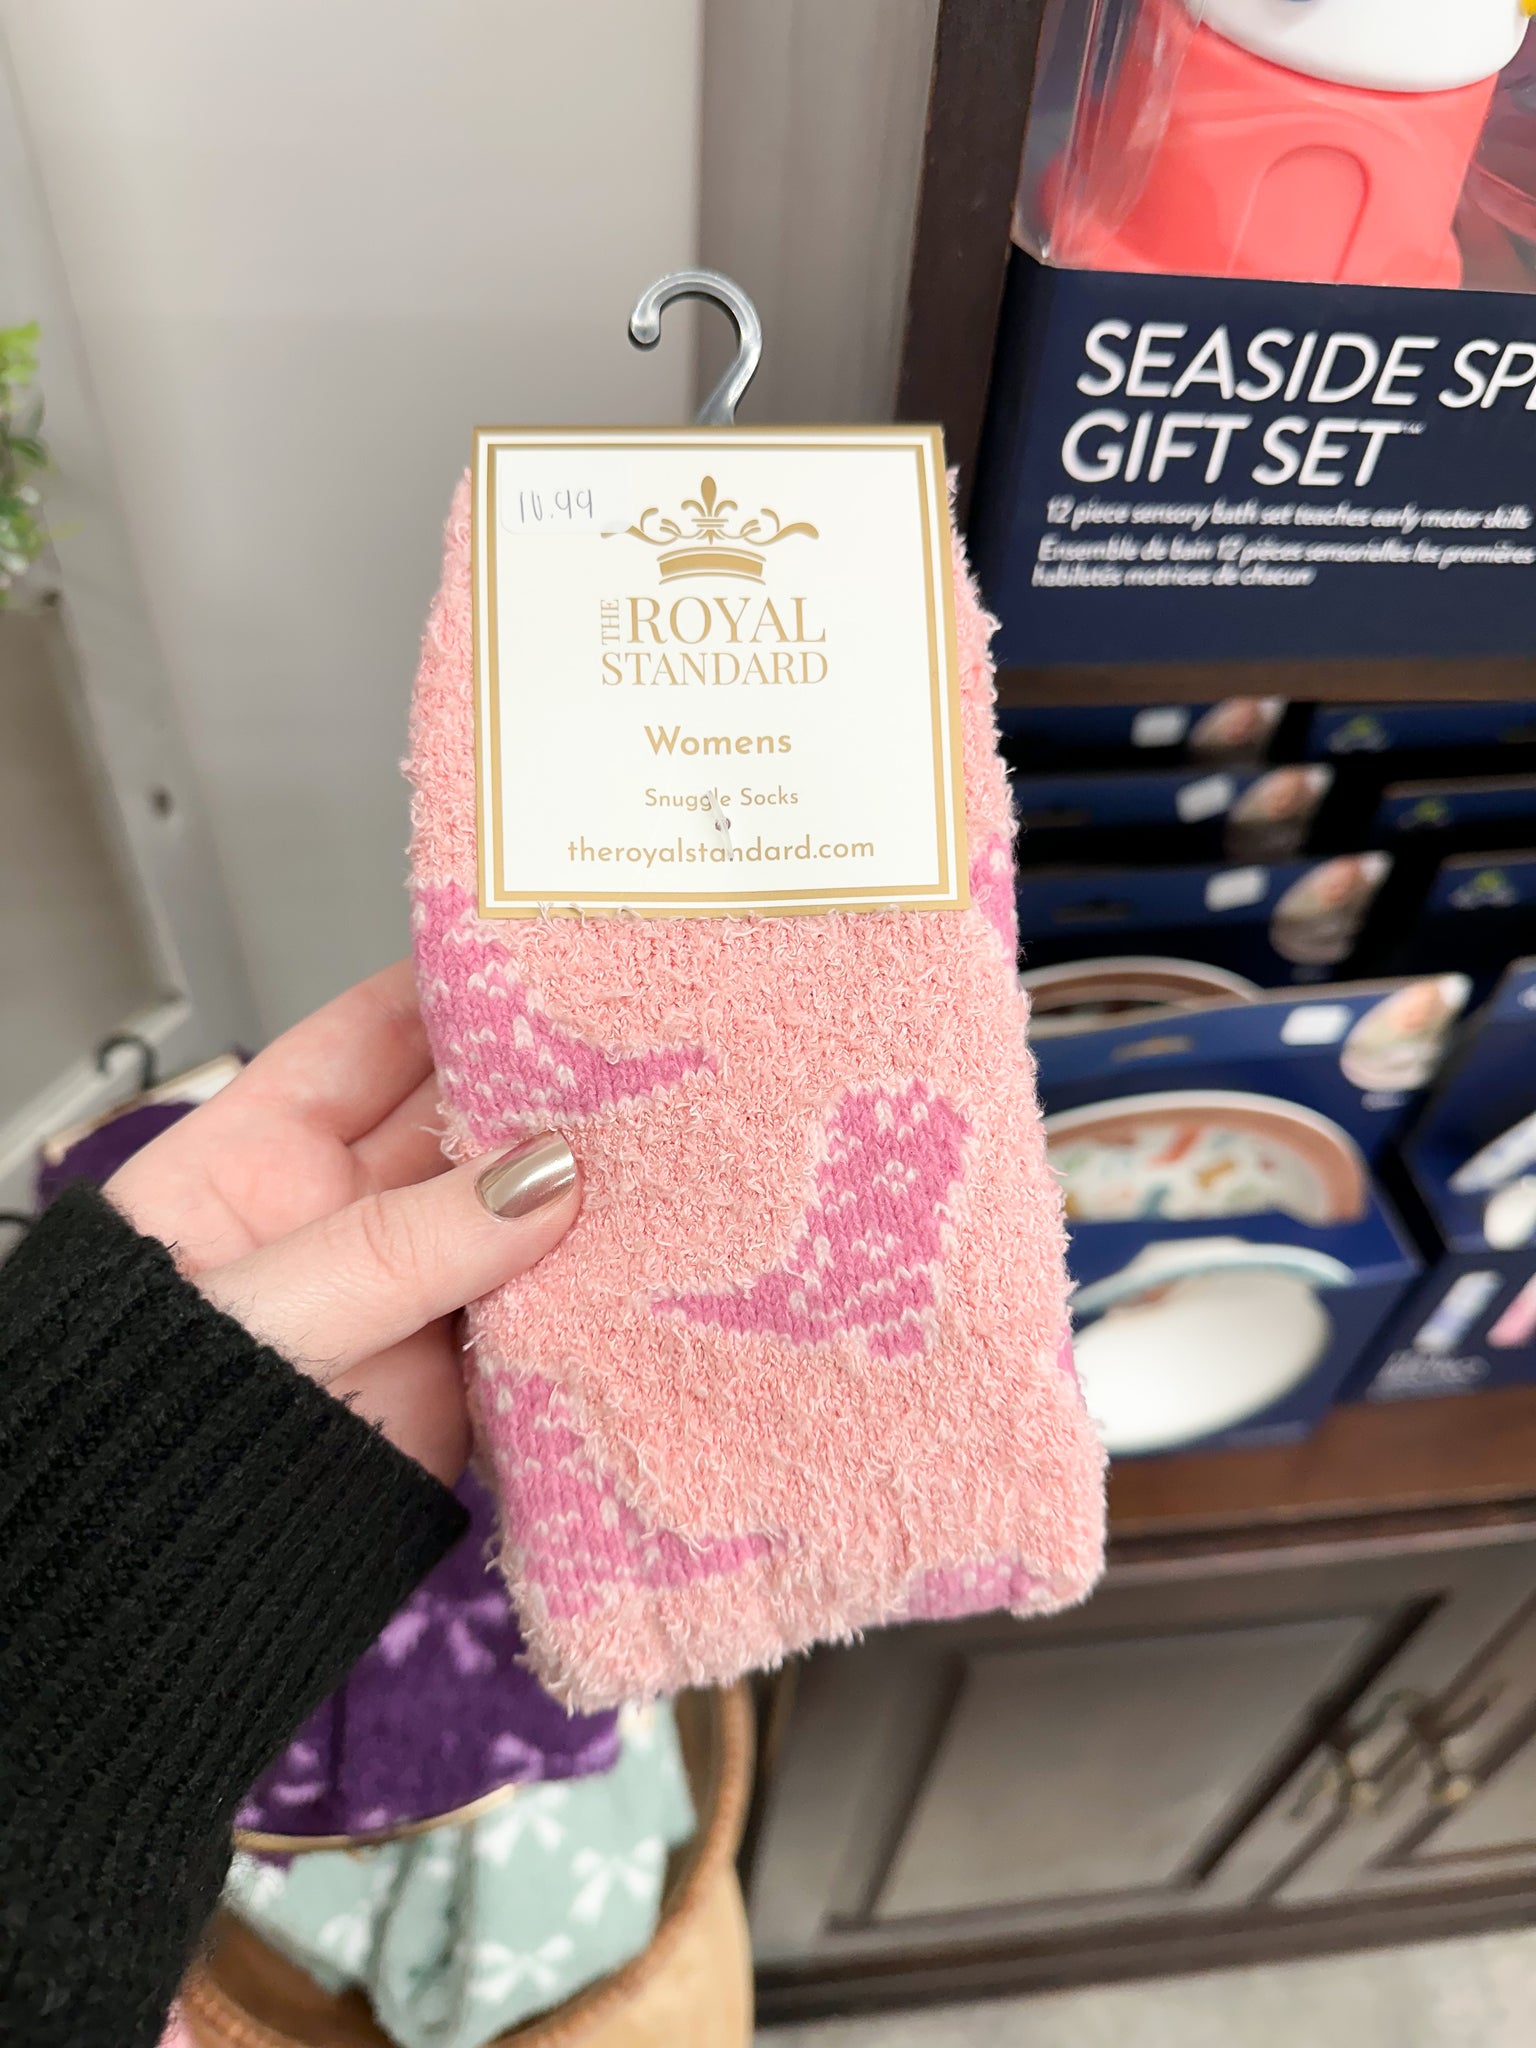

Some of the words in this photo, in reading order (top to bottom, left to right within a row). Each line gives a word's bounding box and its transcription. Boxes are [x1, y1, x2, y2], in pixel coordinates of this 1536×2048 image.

[1076, 319, 1440, 406] SEASIDE
[1438, 338, 1536, 411] SP
[1061, 408, 1253, 484] GIFT
[519, 488, 593, 524] 10.99
[1047, 494, 1076, 524] 12
[1071, 495, 1130, 531] piece
[1130, 502, 1212, 532] sensory
[1210, 495, 1260, 525] bath
[1259, 502, 1297, 526] set
[1294, 499, 1373, 527] teaches
[1370, 500, 1422, 535] early
[1420, 508, 1485, 529] motor
[1481, 503, 1533, 529] skills
[1038, 531, 1140, 561] Ensemble
[1140, 533, 1170, 561] de
[1169, 533, 1217, 561] bain
[1216, 533, 1247, 561] 12
[1212, 562, 1241, 586] de
[600, 598, 620, 645] THE
[626, 595, 827, 645] ROYAL
[601, 651, 829, 687] STANDARD
[643, 725, 793, 757] Womens
[644, 787, 732, 812] Snuggle
[740, 785, 799, 807] Socks
[567, 834, 875, 869] theroyalstandard.com
